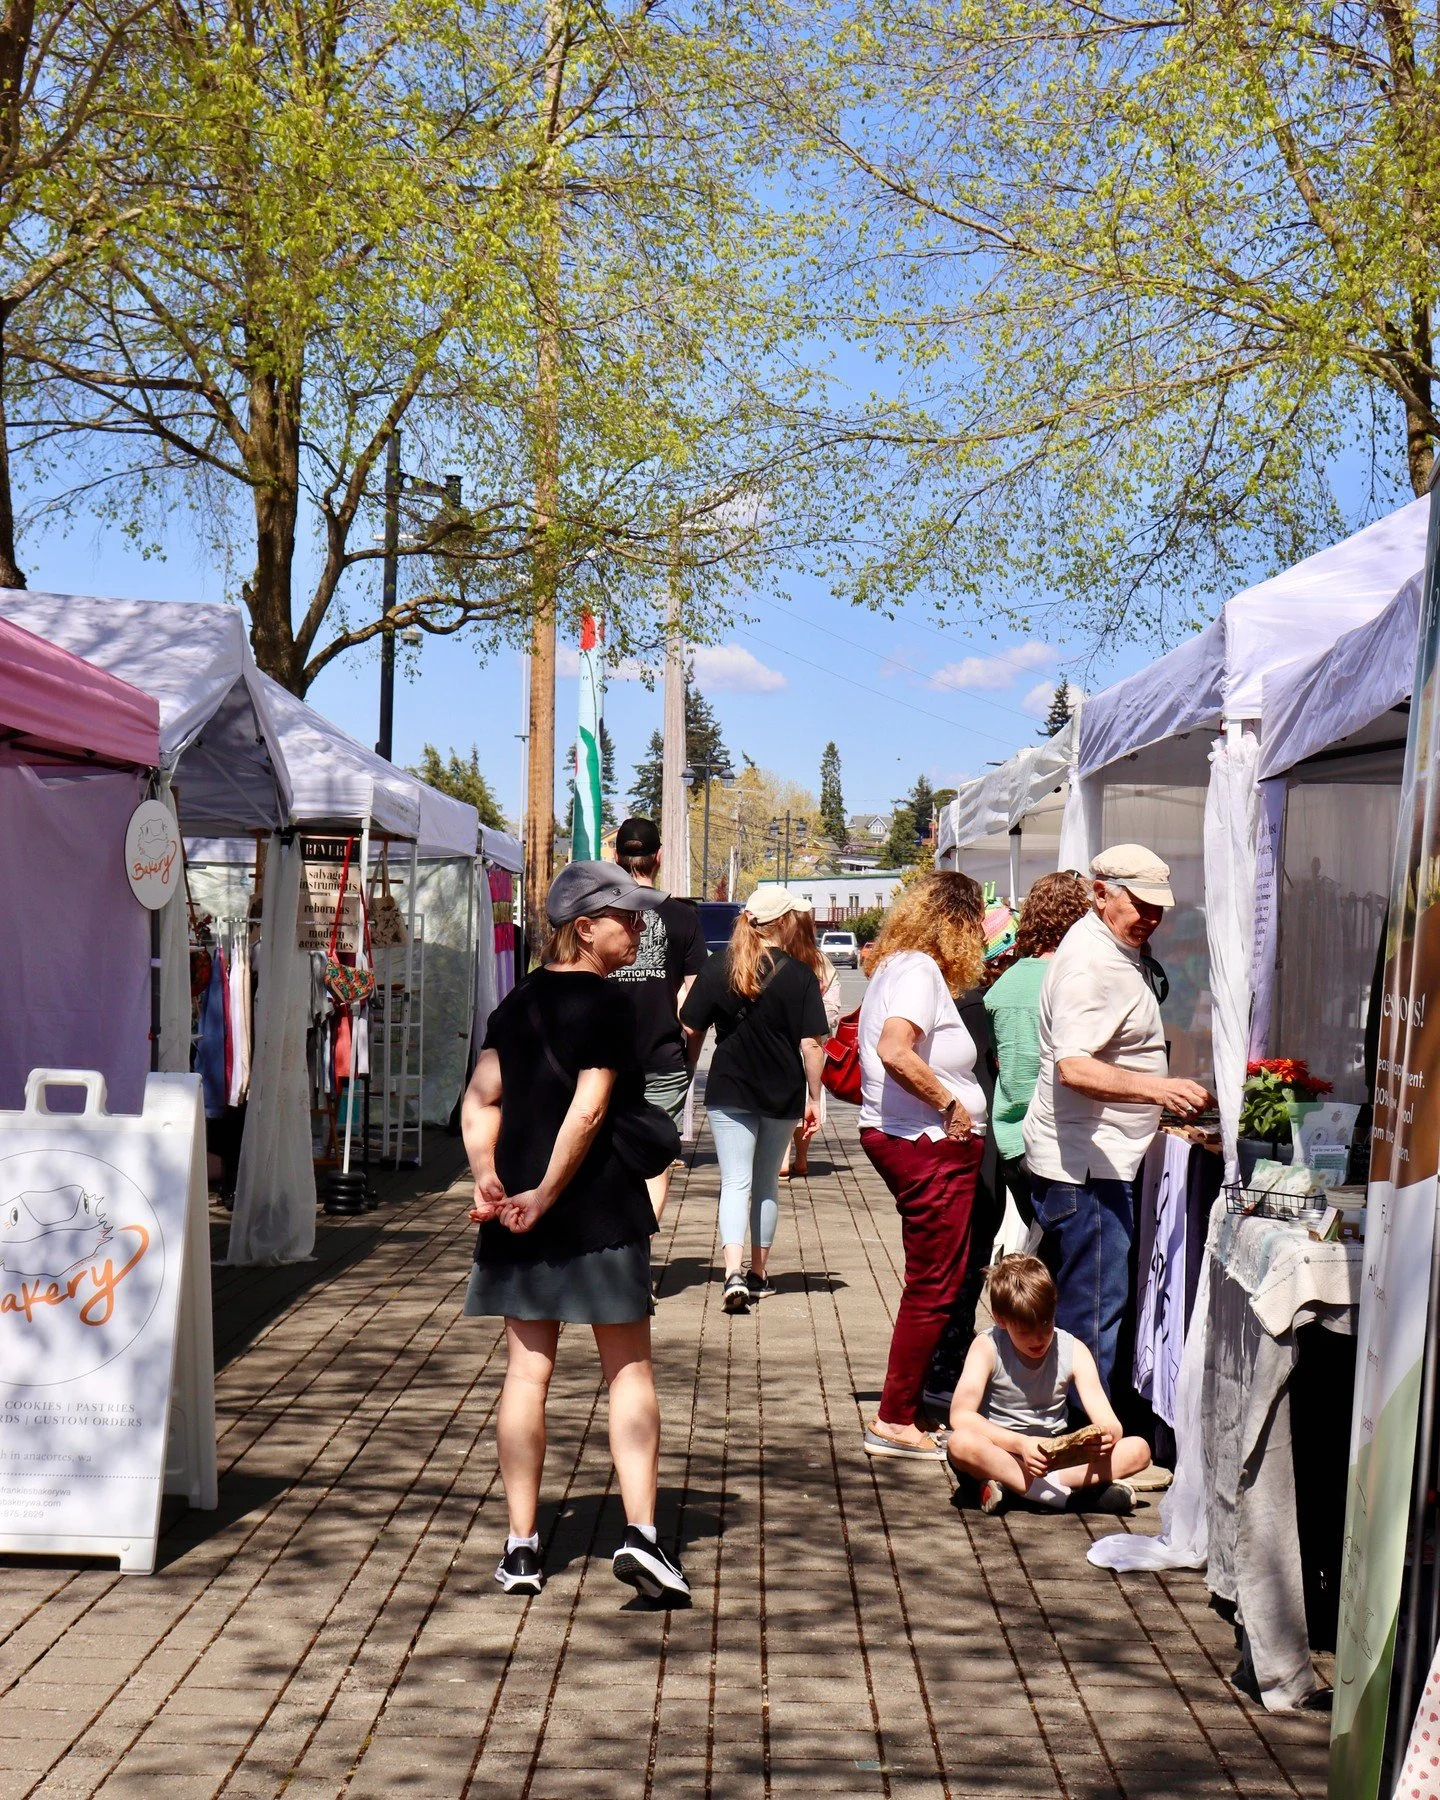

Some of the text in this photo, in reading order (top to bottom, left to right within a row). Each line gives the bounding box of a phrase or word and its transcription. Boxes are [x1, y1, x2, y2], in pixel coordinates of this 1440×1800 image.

[131, 840, 177, 884] Bakery
[304, 902, 336, 914] reborn
[308, 928, 345, 939] moden
[298, 939, 354, 950] accessries
[605, 969, 666, 978] ECEPTION PASS
[4, 1400, 136, 1414] COOKIES PASTRIES
[34, 1415, 89, 1426] CUSTOM
[92, 1416, 143, 1428] ORDERS
[10, 1450, 21, 1460] in
[78, 1453, 92, 1462] wa
